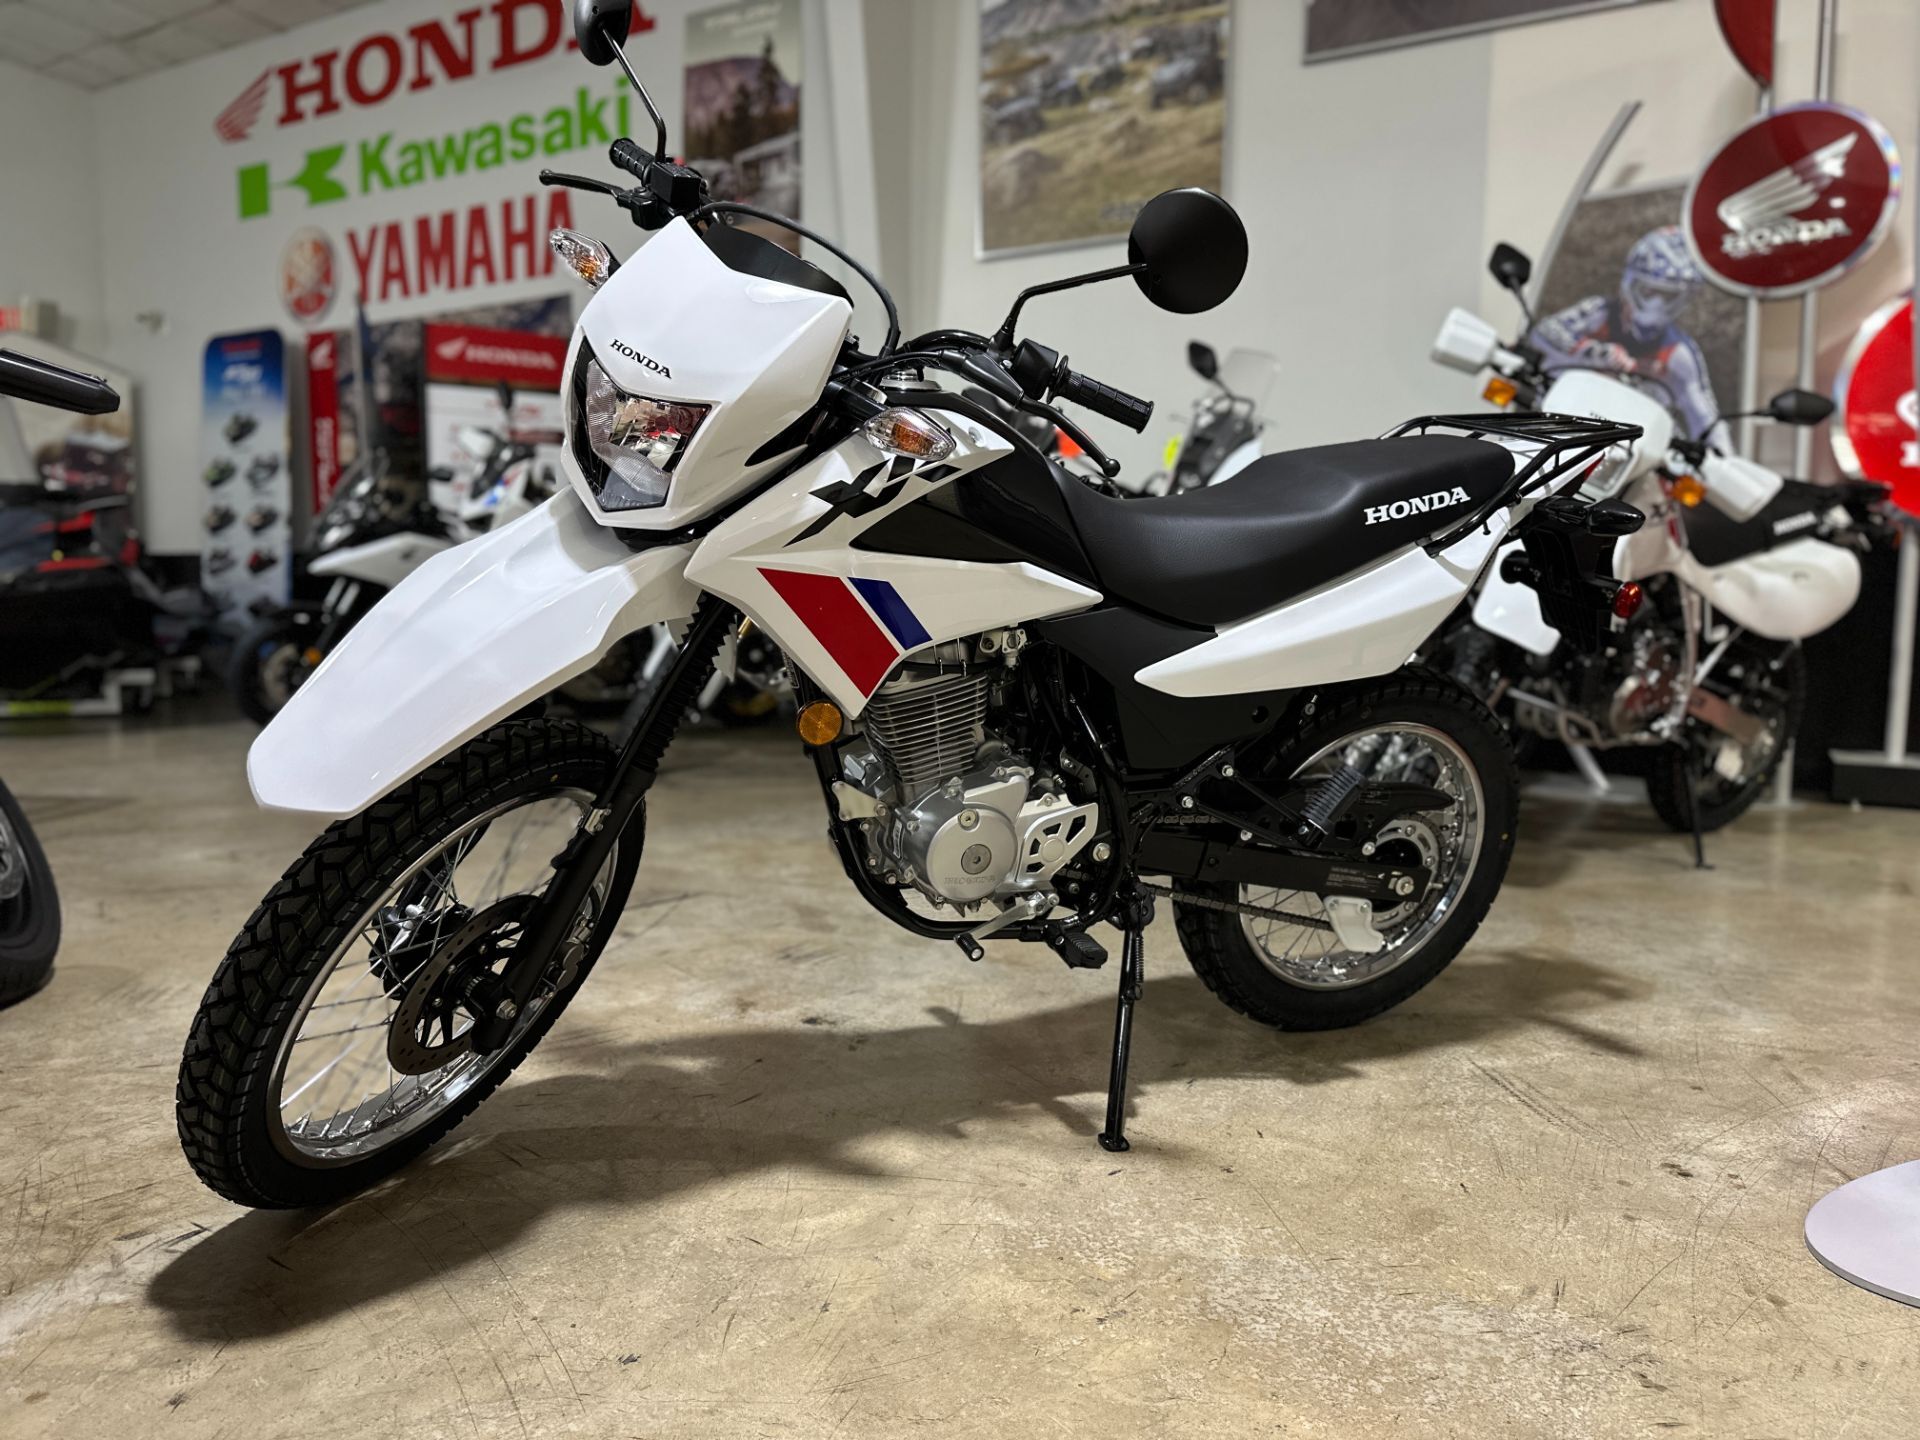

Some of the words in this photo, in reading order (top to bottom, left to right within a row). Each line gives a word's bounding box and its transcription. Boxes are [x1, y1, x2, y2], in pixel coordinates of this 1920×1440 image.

[358, 75, 631, 195] Kawasaki
[346, 188, 575, 305] YAMAHA
[609, 338, 672, 380] HONDA
[1363, 486, 1471, 525] HONDA
